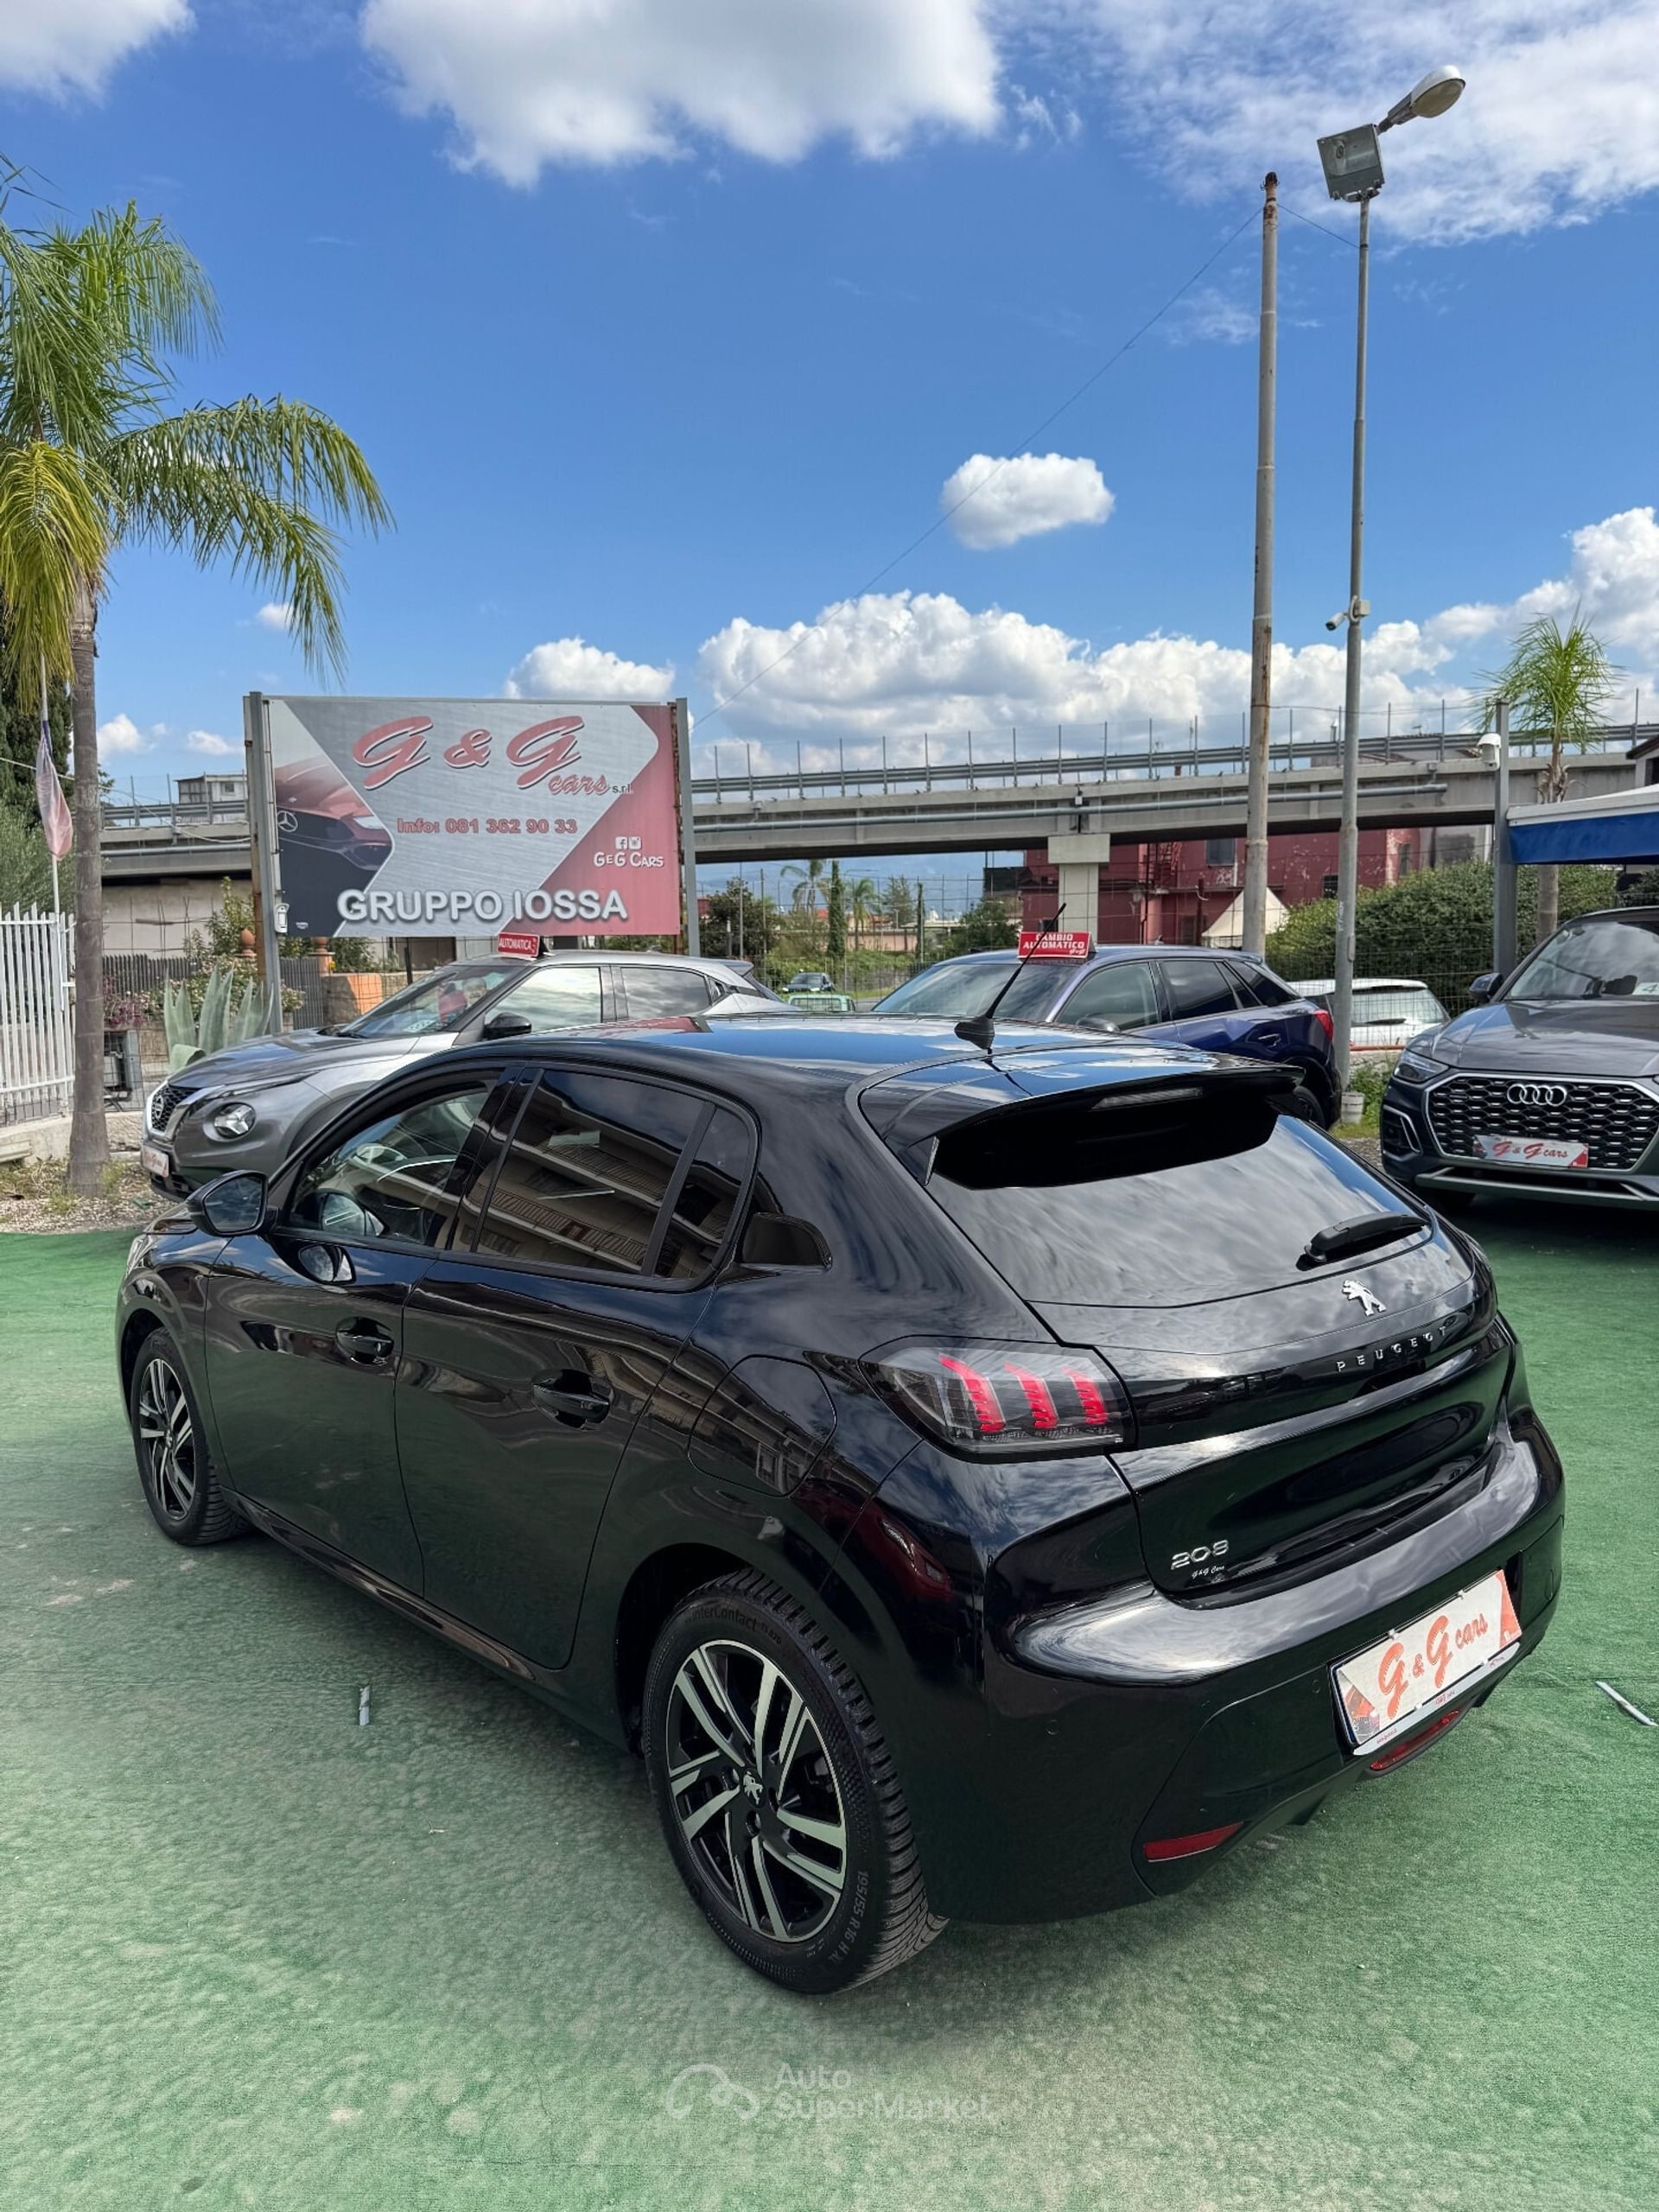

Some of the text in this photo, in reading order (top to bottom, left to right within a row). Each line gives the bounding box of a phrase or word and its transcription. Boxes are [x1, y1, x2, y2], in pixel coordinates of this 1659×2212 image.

[353, 715, 433, 790] G
[443, 728, 493, 768] &
[506, 715, 585, 790] G
[549, 774, 611, 795] cars
[397, 817, 578, 834] Info: 081 362 90 33
[337, 889, 628, 921] GRUPPO IOSSA
[1336, 1325, 1446, 1372] PEUGEOT
[1170, 1539, 1228, 1570] 208
[1378, 1613, 1488, 1719] G & G cars
[853, 1870, 869, 1917] 195/55
